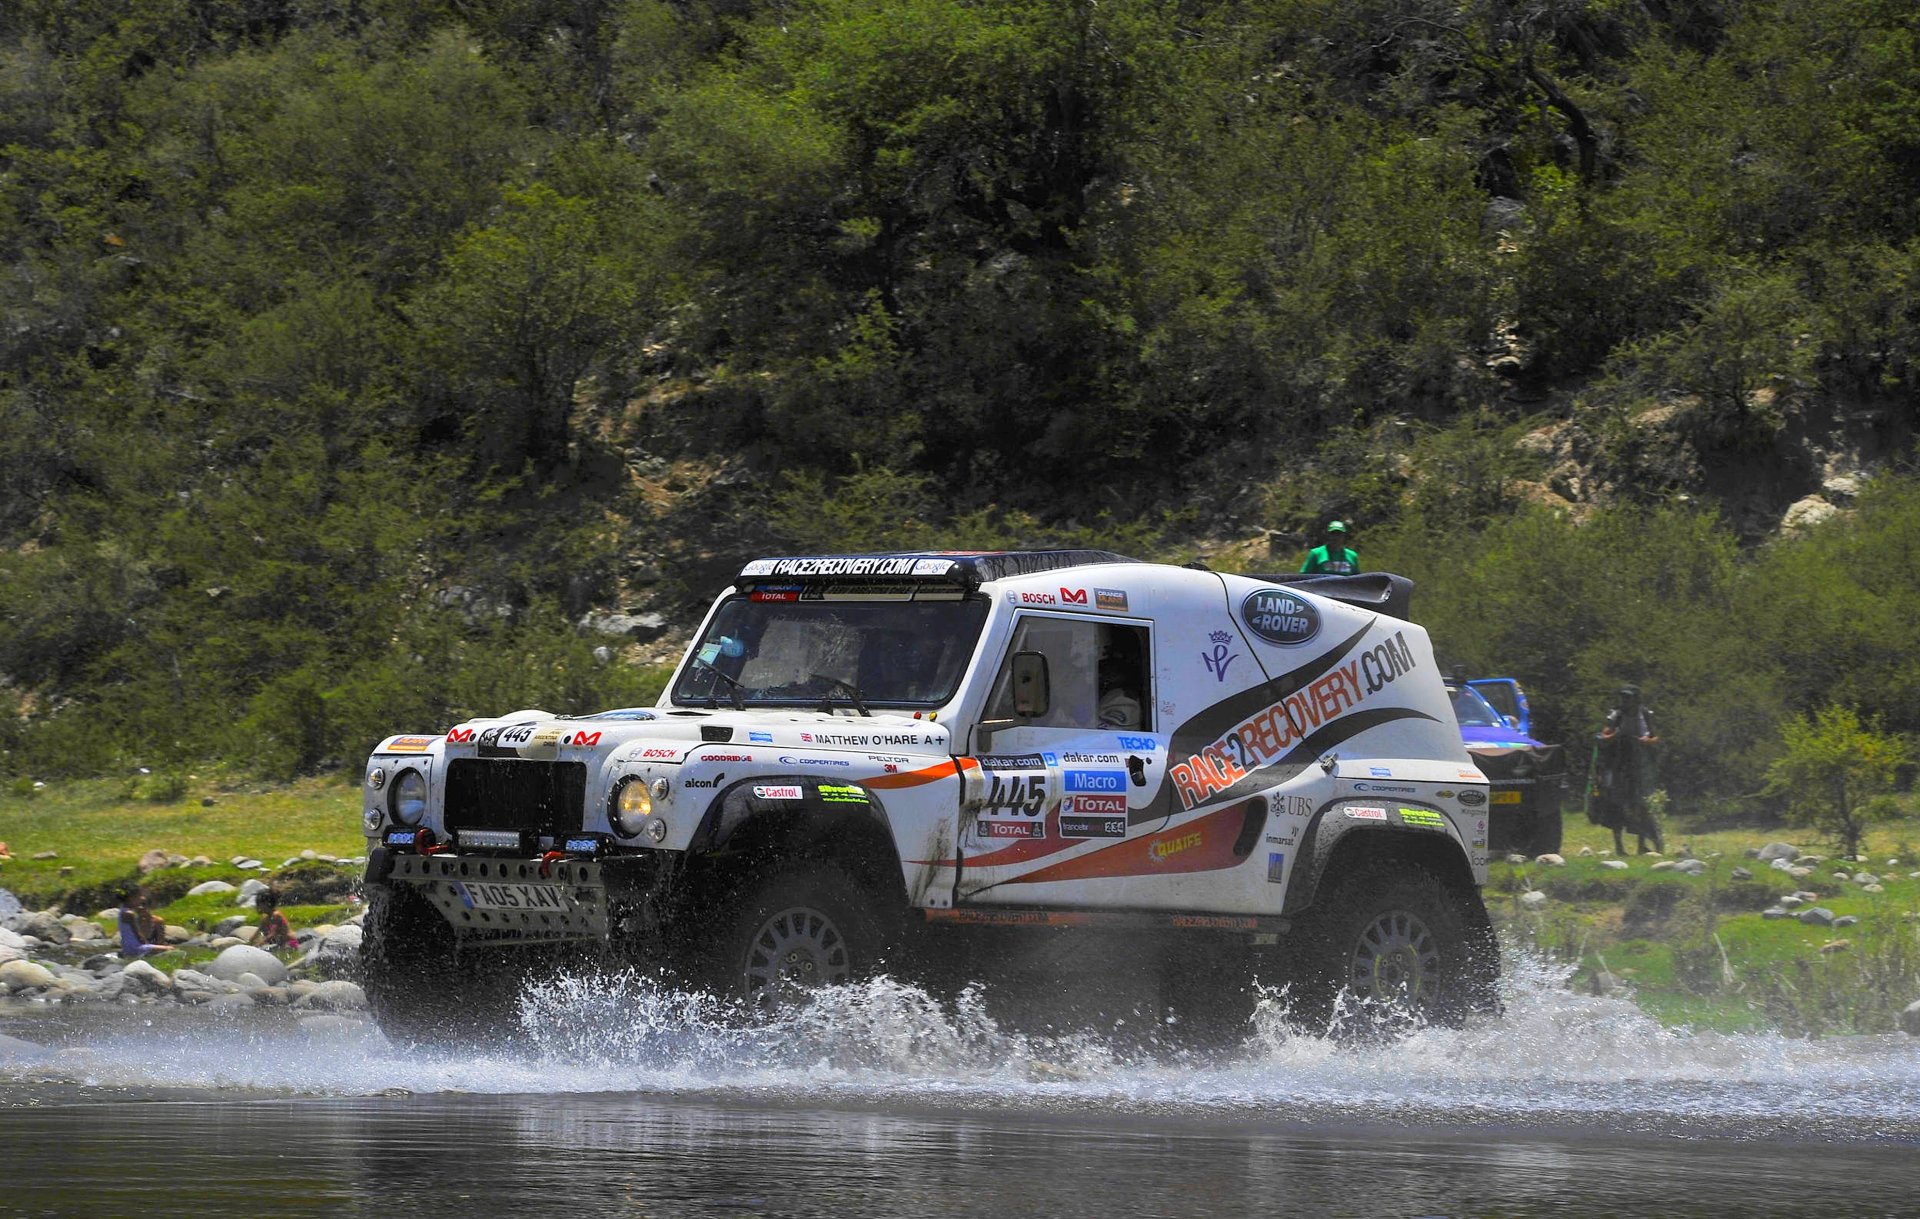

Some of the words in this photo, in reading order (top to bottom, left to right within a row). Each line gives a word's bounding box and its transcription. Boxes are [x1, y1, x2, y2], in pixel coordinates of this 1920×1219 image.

[775, 558, 917, 575] RACE2RECOVERY.COM
[914, 560, 949, 575] Google
[1021, 592, 1056, 605] BOSCH
[1256, 596, 1296, 615] LAND
[1261, 615, 1309, 634] ROVER
[1169, 630, 1417, 811] RACE2RECOVERY.COM
[503, 727, 536, 743] 445
[815, 734, 868, 746] MATTHEW
[872, 735, 919, 745] O'HARE
[1117, 736, 1157, 751] TECHO
[643, 749, 677, 758] BOSCH
[868, 755, 910, 763] PELTOR
[1062, 752, 1120, 764] dakar.com
[884, 764, 898, 774] 3M
[982, 755, 1042, 768] dakar.com
[685, 778, 712, 788] alcon
[1074, 773, 1118, 789] Macro
[765, 787, 797, 799] Castrol
[982, 775, 1047, 817] 445
[1078, 797, 1125, 812] TOTAL
[1287, 795, 1313, 817] UBS
[1354, 809, 1382, 818] Castrol
[991, 824, 1031, 835] TOTAL
[1157, 832, 1203, 858] QUAIFE
[463, 883, 520, 907] FA05
[516, 885, 561, 908] XAV
